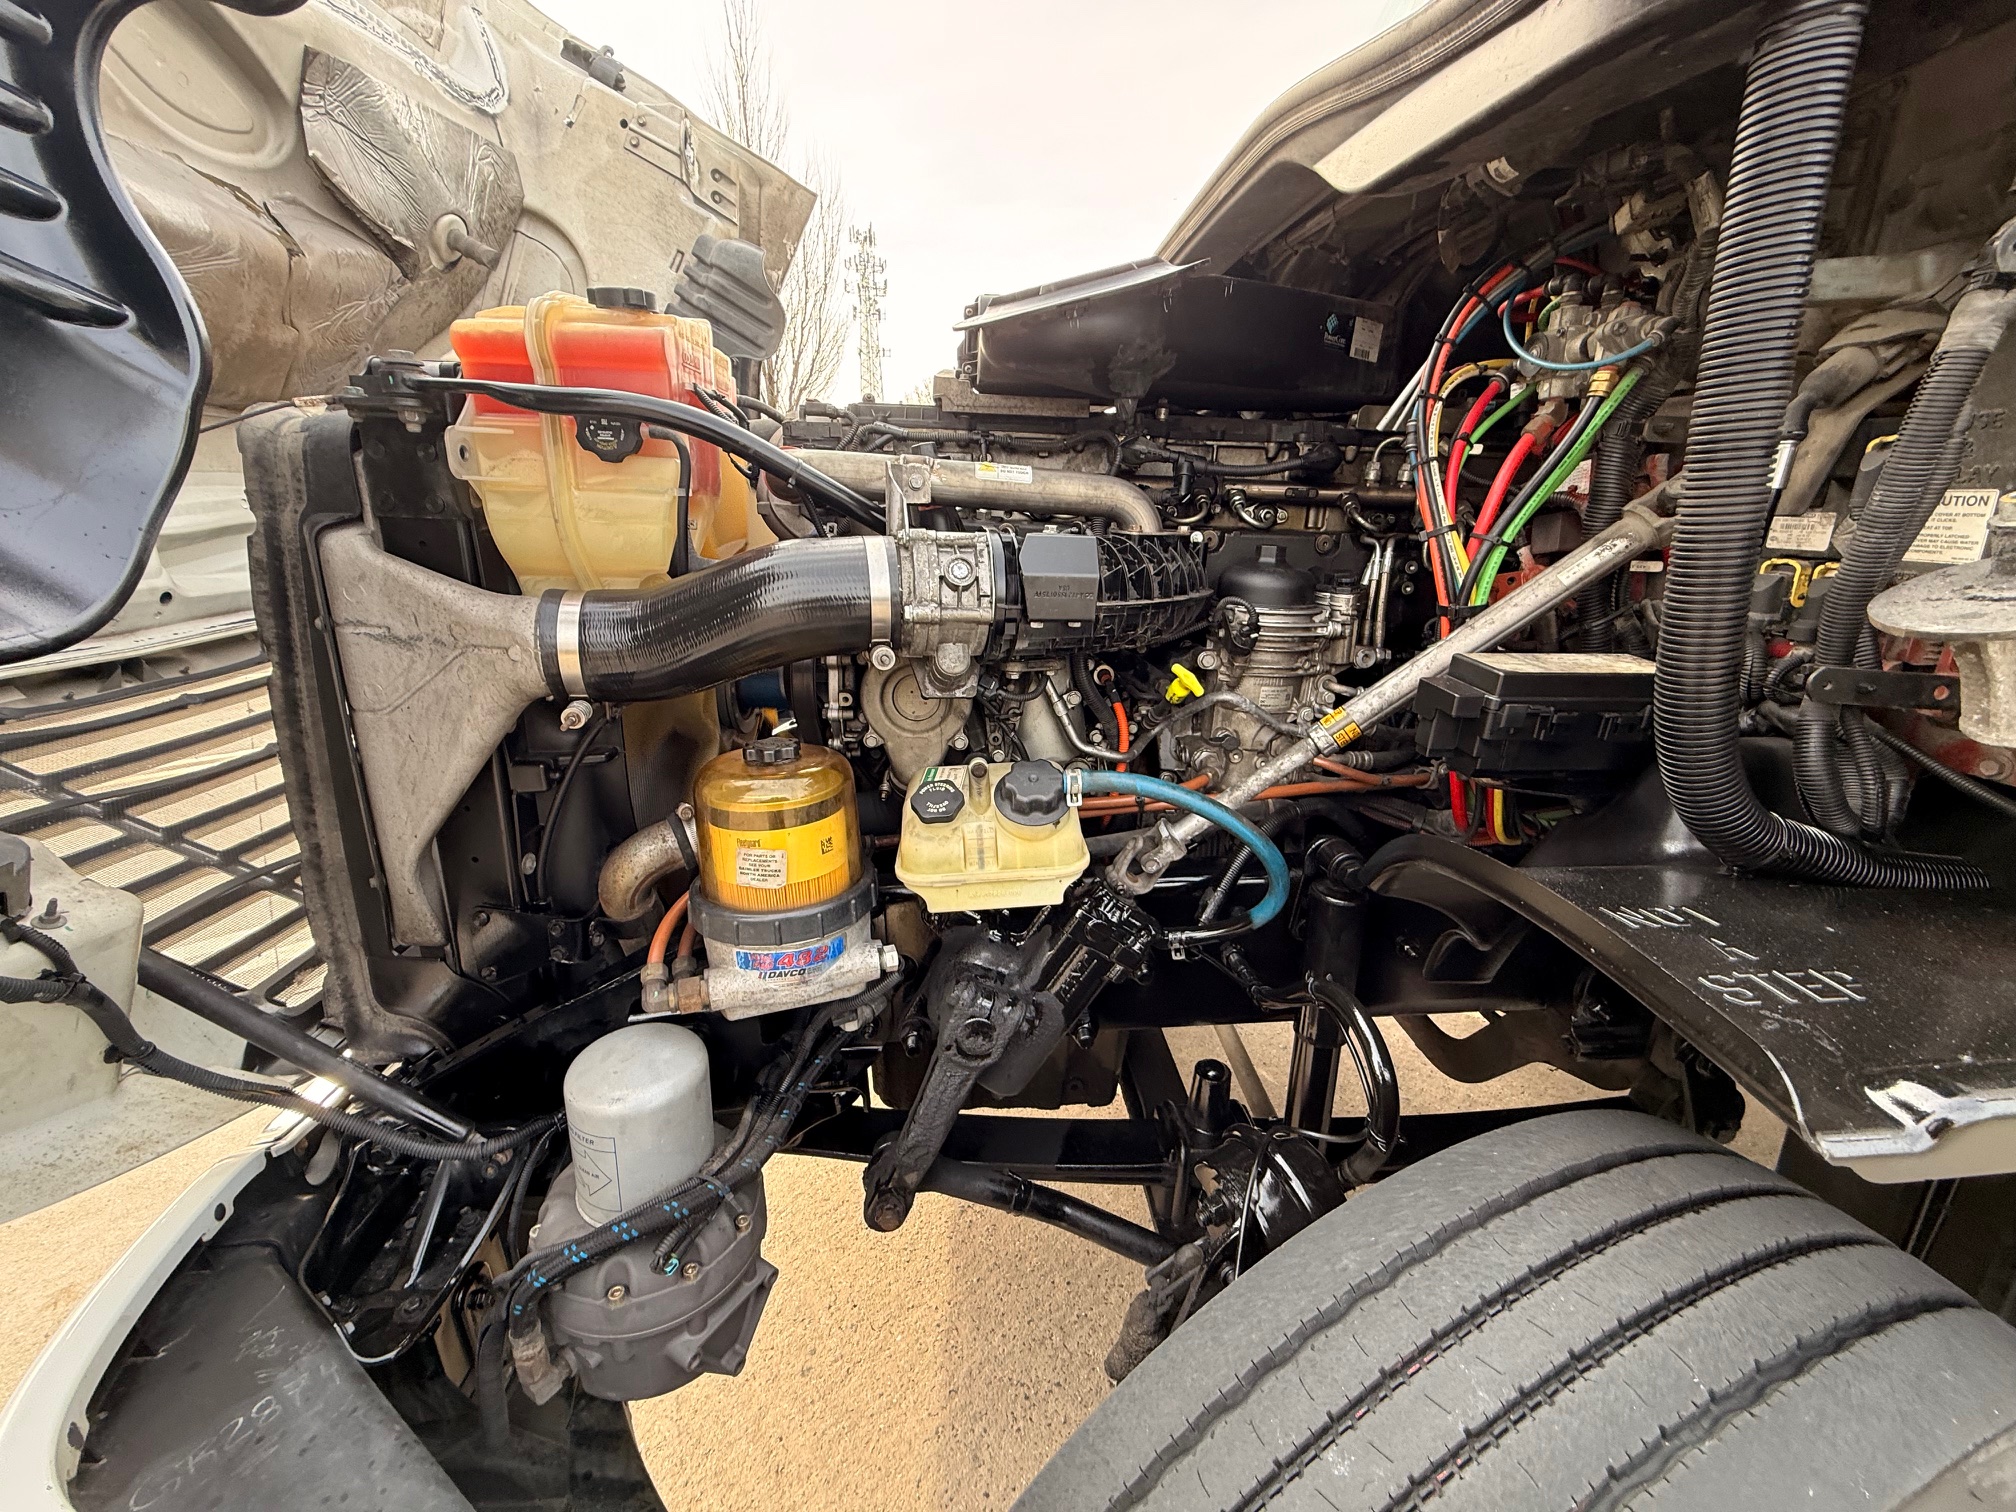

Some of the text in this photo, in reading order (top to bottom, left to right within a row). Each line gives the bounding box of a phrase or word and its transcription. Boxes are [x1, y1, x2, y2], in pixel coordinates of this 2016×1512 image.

[1941, 495, 1990, 507] UTION
[777, 945, 829, 969] 482
[768, 968, 807, 979] DAVCO
[1697, 968, 1867, 1006] STEP
[575, 1131, 595, 1146] FILTER
